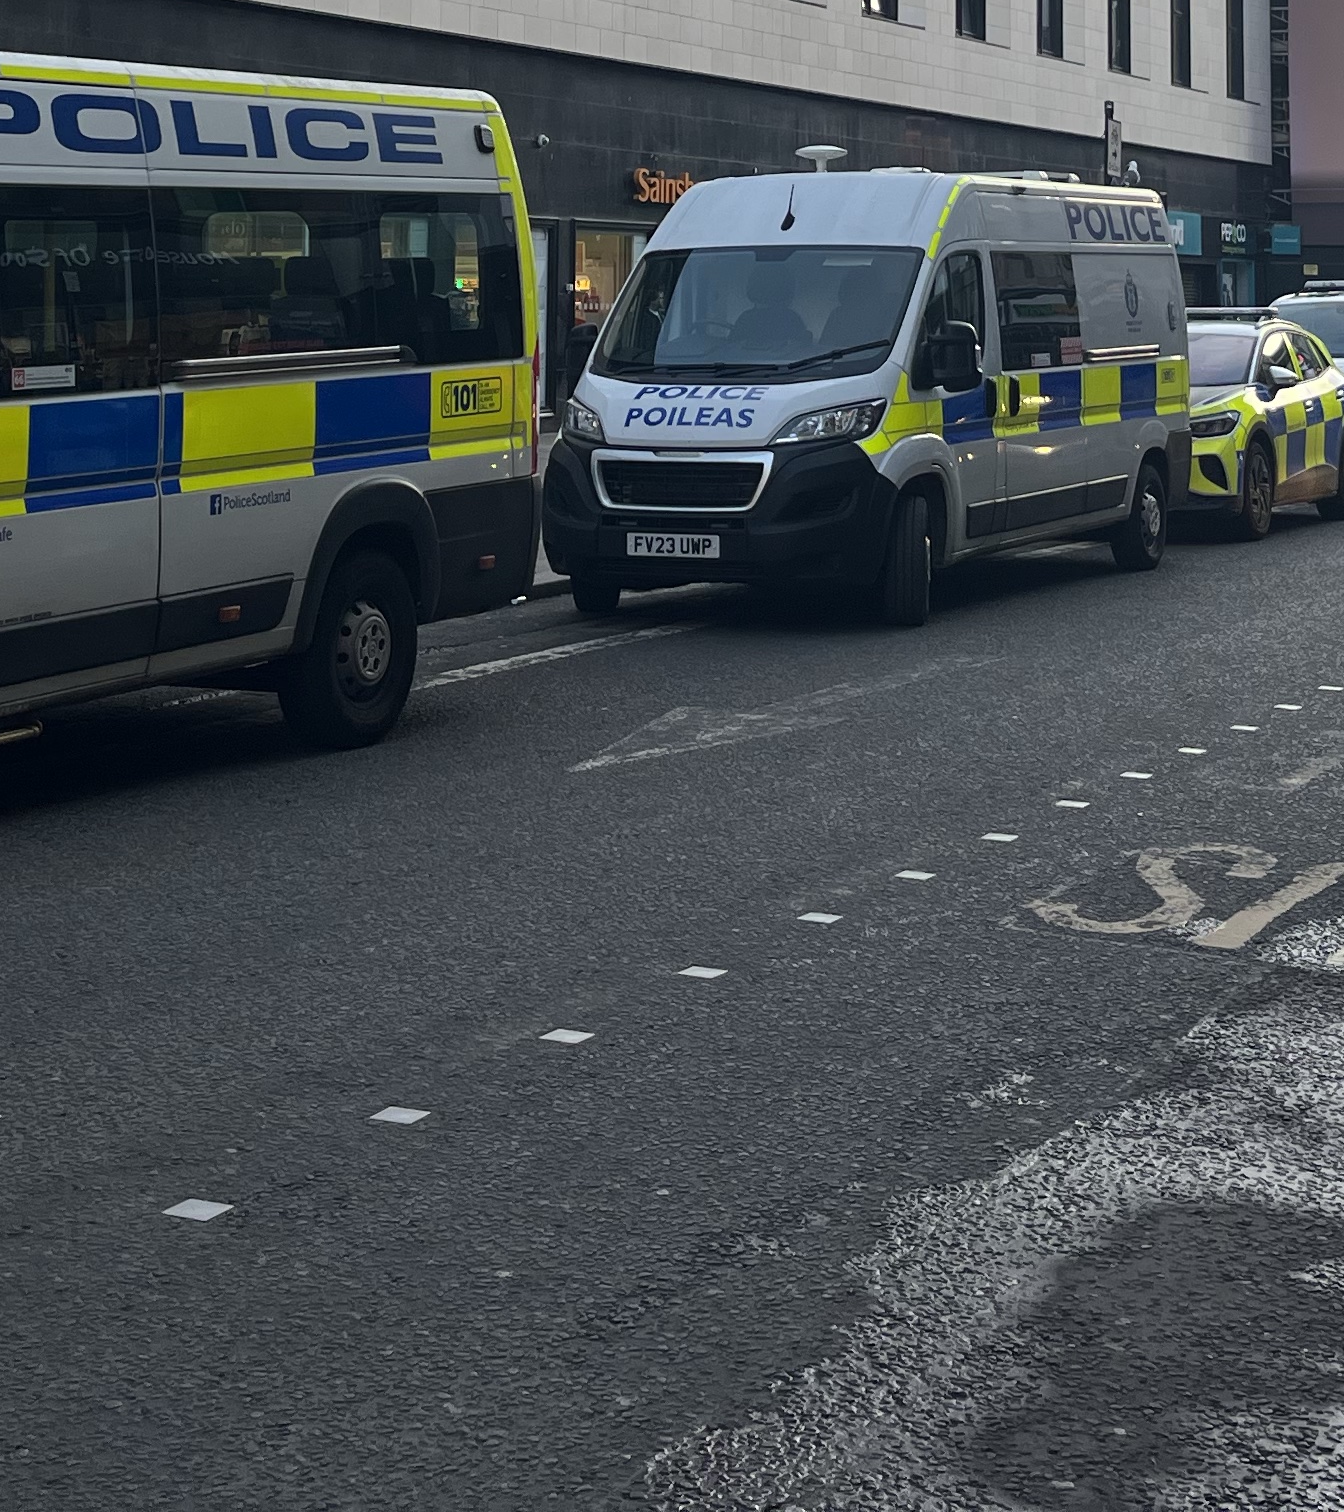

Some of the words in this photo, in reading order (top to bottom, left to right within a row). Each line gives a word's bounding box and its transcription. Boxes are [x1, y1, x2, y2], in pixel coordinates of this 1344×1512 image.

[1063, 201, 1166, 242] POLICE
[453, 383, 477, 413] 101
[634, 386, 770, 401] POLICE
[624, 406, 755, 429] POILEAS
[223, 489, 291, 510] PoliceScotland
[634, 535, 675, 554] FV23
[679, 537, 712, 555] UWP
